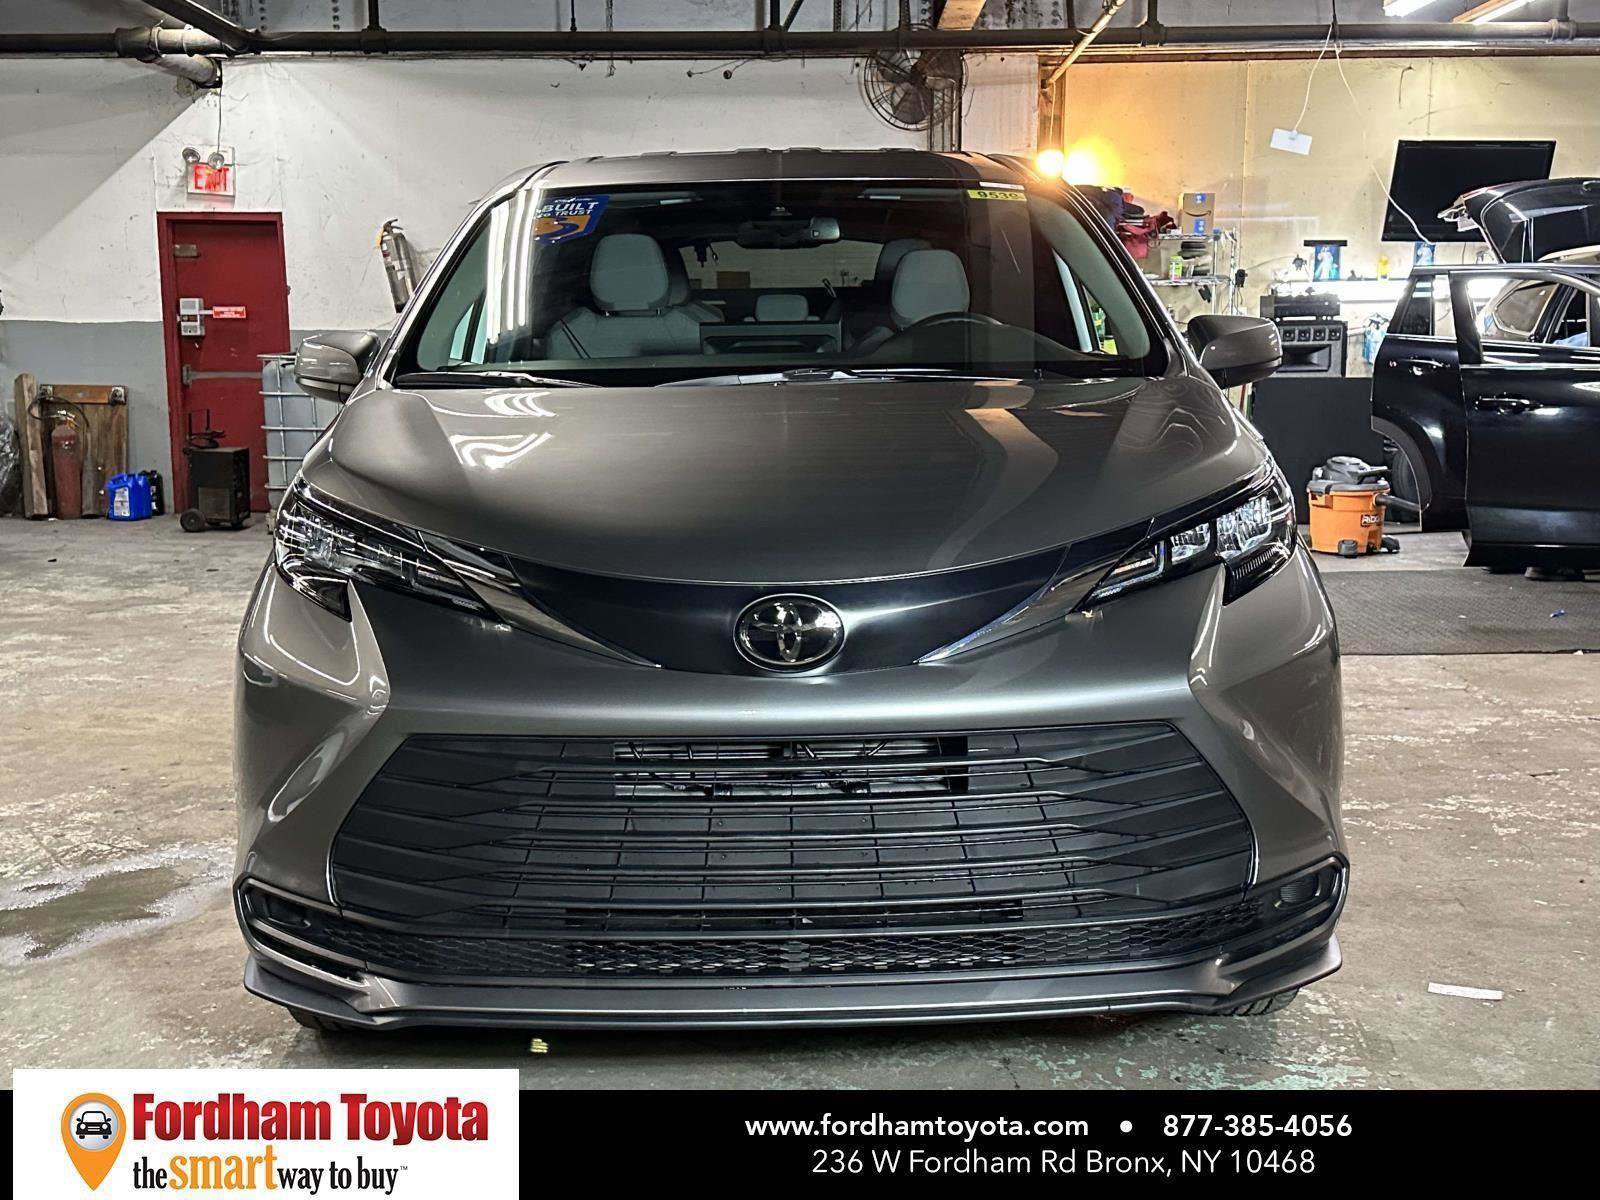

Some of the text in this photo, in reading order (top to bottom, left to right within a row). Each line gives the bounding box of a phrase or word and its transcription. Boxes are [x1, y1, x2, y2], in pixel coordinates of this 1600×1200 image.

[193, 163, 229, 191] EXIT
[541, 201, 599, 213] BUILT
[555, 209, 593, 217] TRUST
